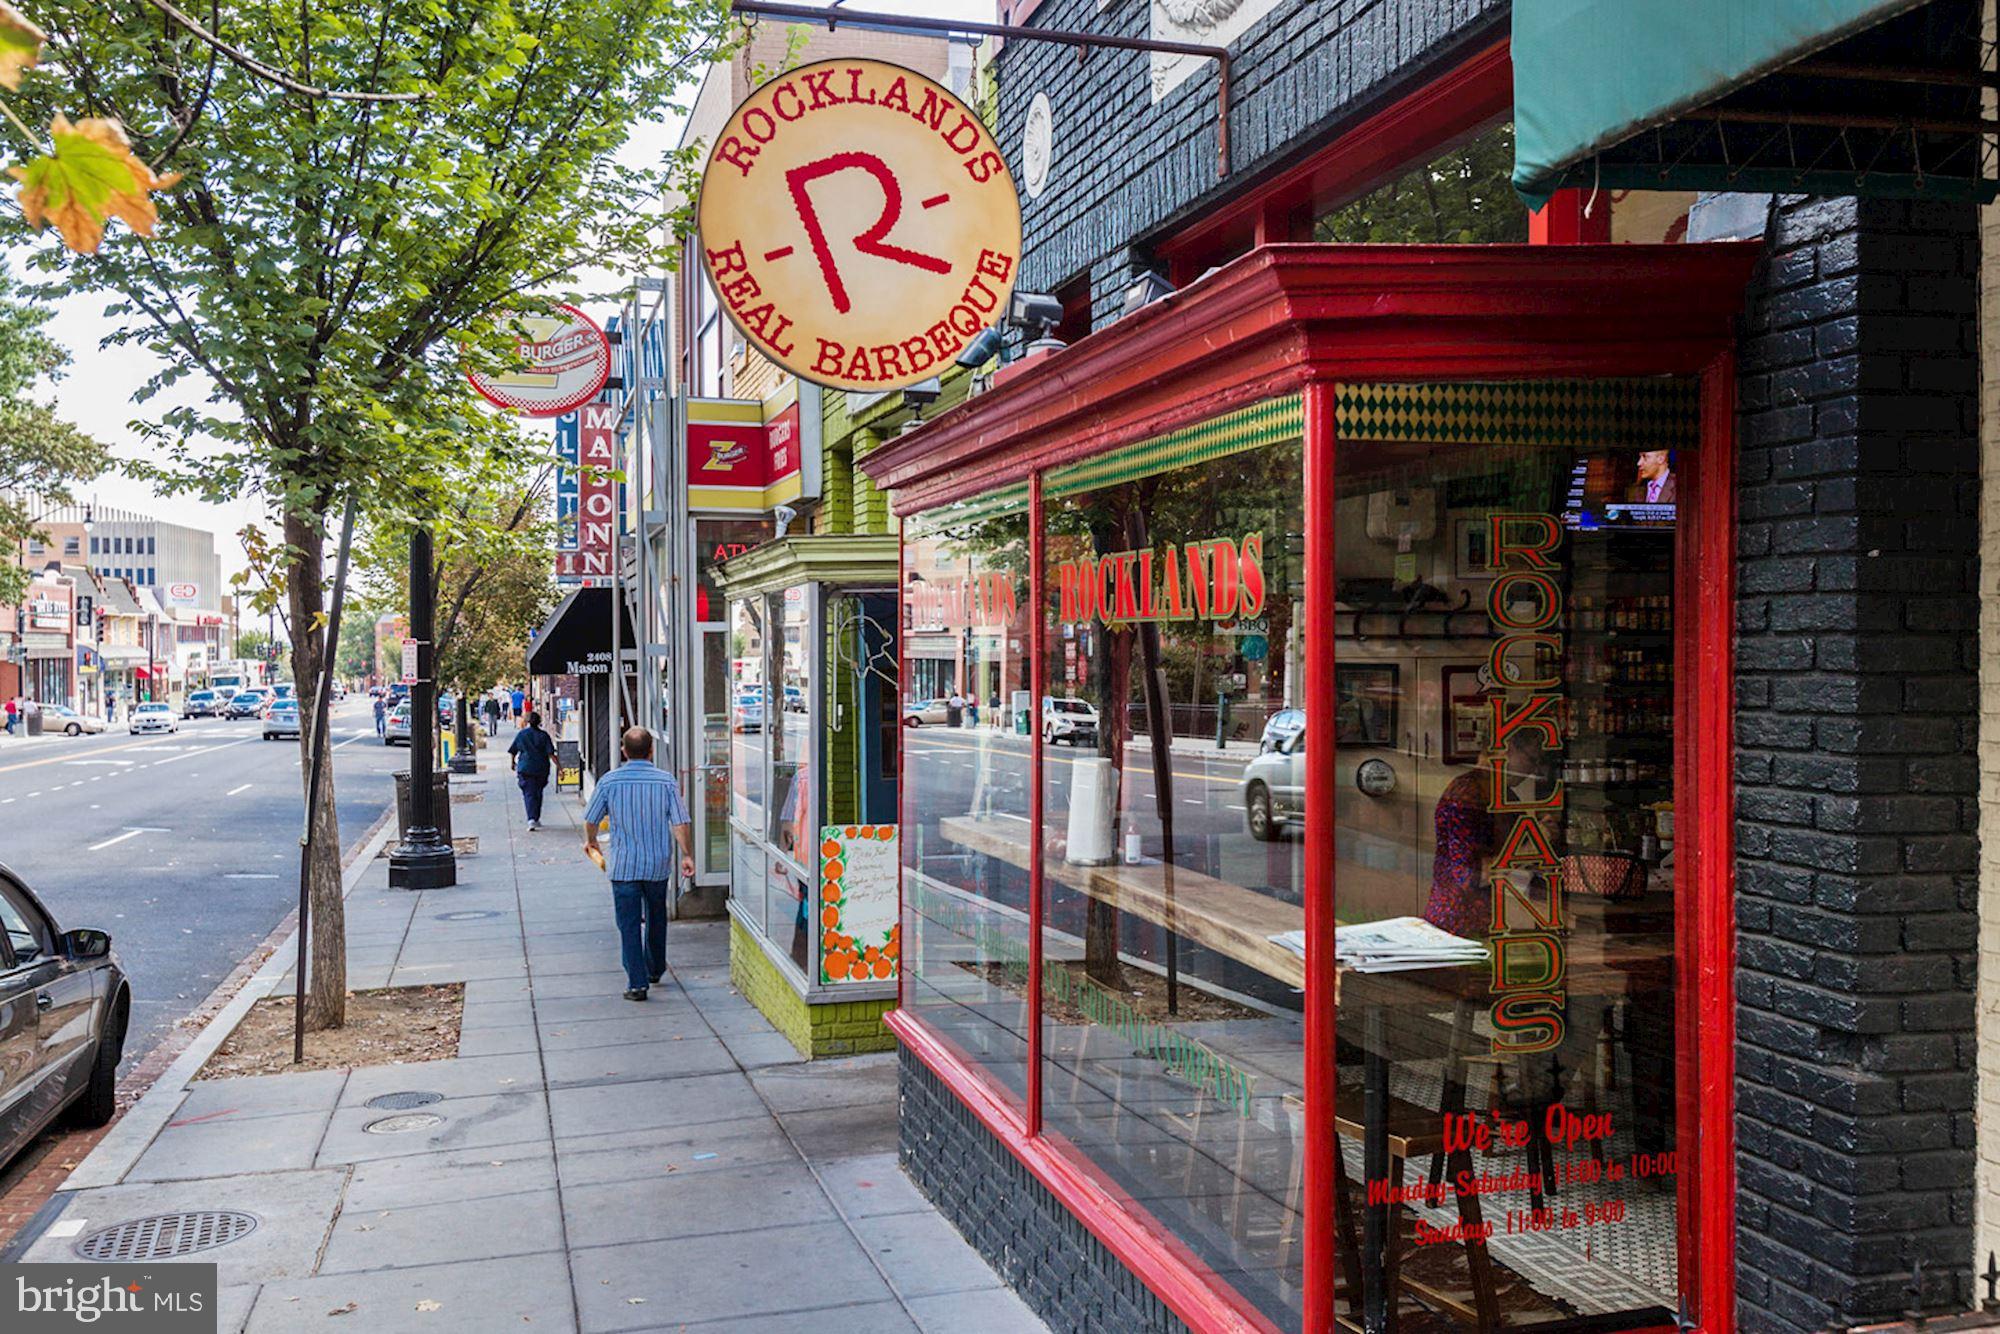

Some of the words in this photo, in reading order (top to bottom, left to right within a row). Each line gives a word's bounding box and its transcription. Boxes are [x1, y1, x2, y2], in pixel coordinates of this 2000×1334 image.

[715, 68, 1003, 184] ROCKLANDS
[786, 151, 952, 314] R
[519, 334, 585, 360] BURGER
[707, 240, 794, 357] REAL
[810, 248, 1012, 381] BARBEQUE
[585, 407, 612, 546] MASON
[1058, 530, 1266, 624] ROCKLANDS
[567, 661, 609, 674] Mason
[587, 652, 612, 661] 2408
[1486, 512, 1565, 1055] ROCKLANDS
[1442, 1110, 1532, 1154] We're
[1544, 1103, 1617, 1151] Open
[1367, 1165, 1543, 1208] Monday-Saturday
[1554, 1159, 1602, 1185] 11:00
[1607, 1158, 1625, 1182] to
[1631, 1151, 1678, 1177] 10:00
[1414, 1218, 1494, 1246] Sundays
[1506, 1207, 1554, 1235] 11:00
[1562, 1208, 1580, 1230] to
[1585, 1200, 1626, 1225] 9:00
